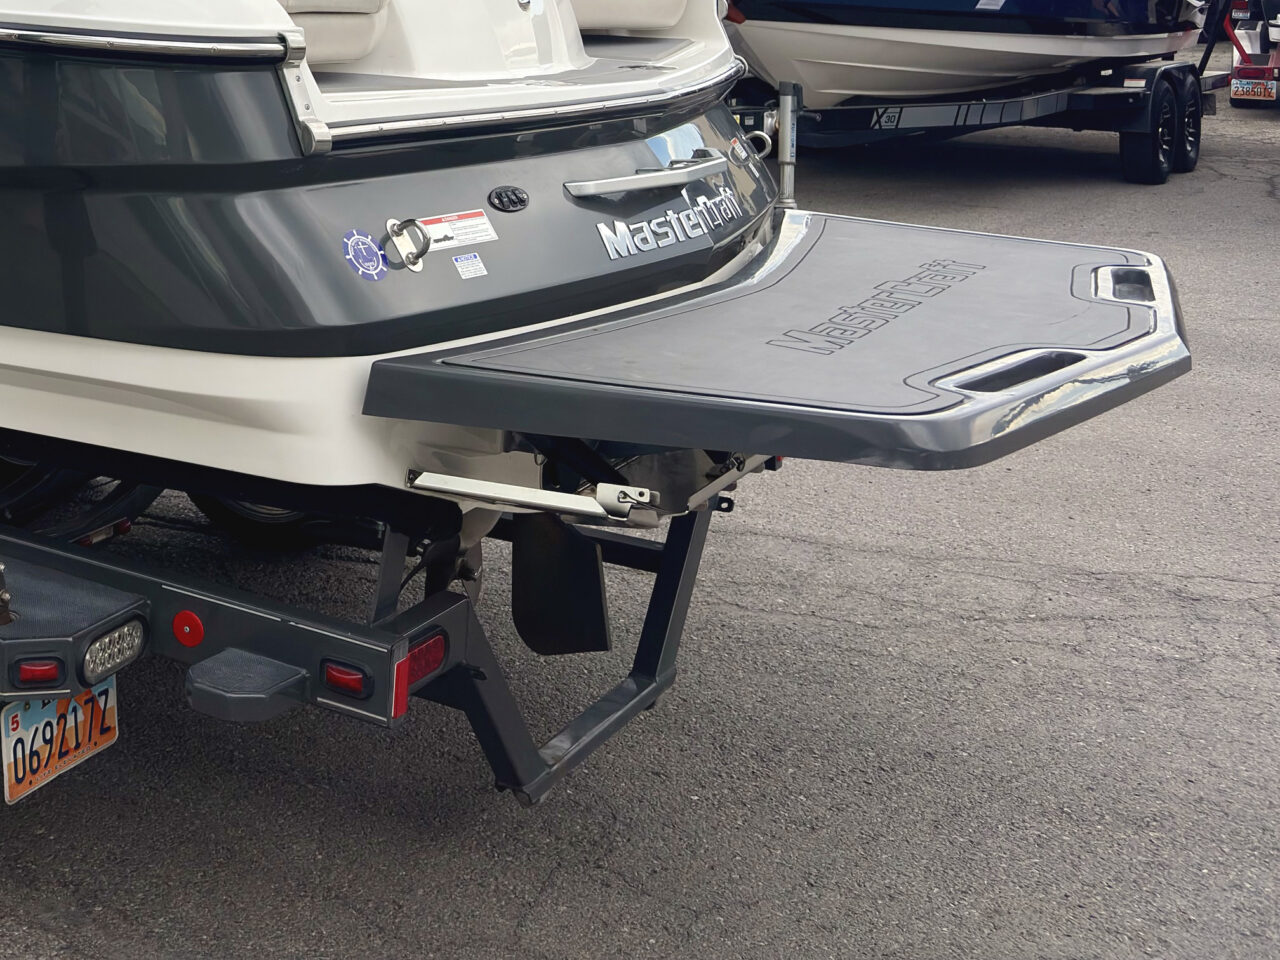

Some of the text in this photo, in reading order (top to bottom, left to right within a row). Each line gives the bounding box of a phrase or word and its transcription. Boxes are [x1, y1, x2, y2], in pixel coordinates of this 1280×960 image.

[595, 187, 743, 261] MasterCraft
[765, 258, 987, 356] MasterCraft
[10, 713, 20, 732] 5
